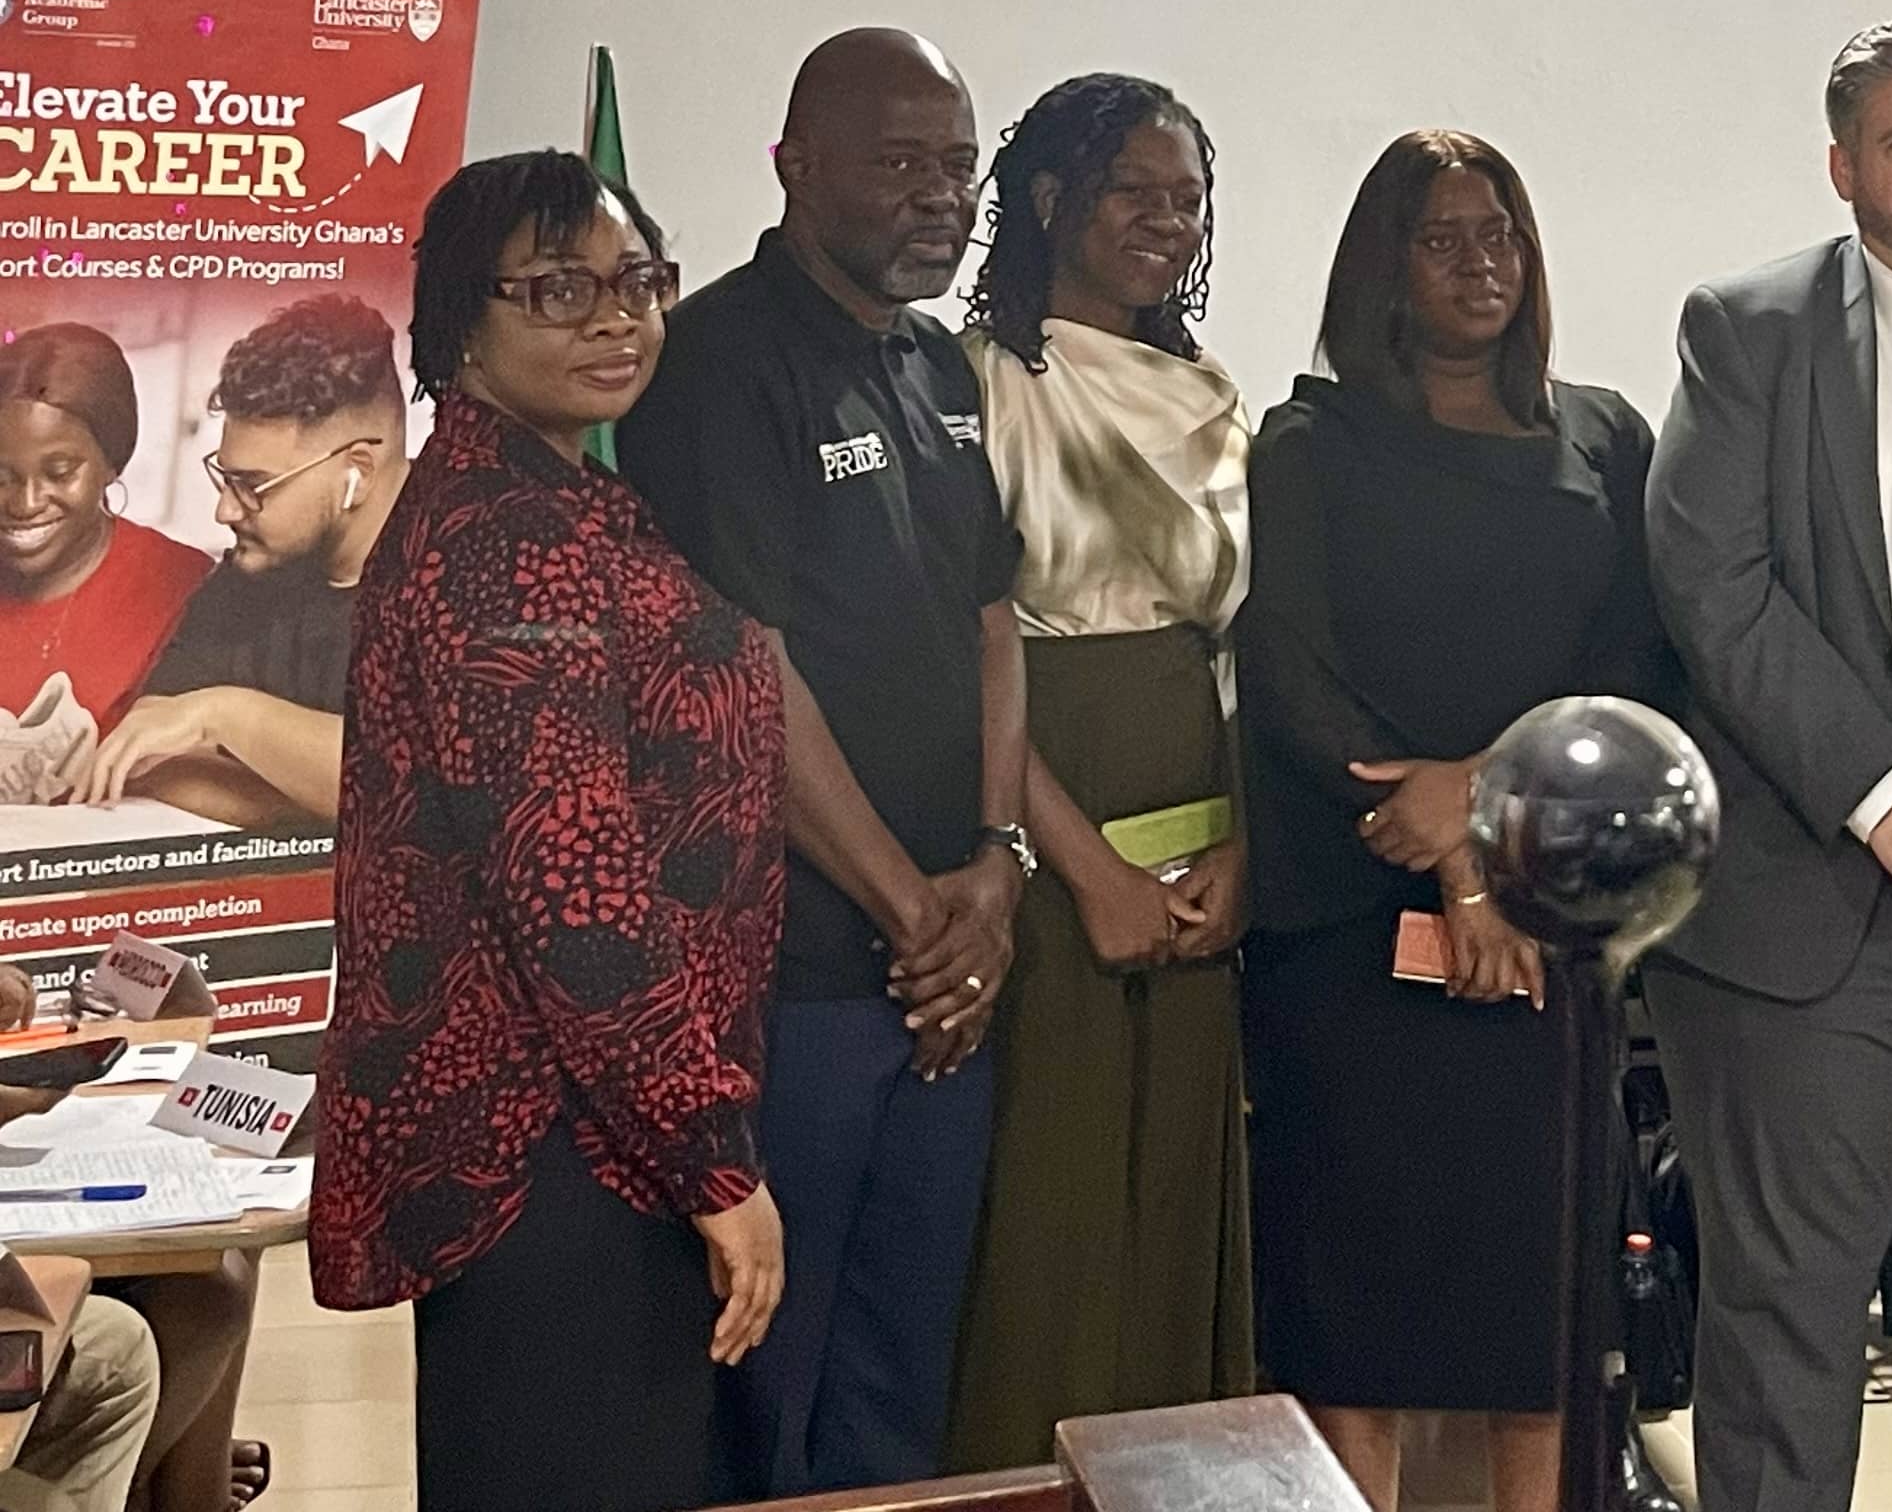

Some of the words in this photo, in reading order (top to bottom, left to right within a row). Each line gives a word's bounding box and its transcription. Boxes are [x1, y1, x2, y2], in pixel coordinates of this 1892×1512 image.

[22, 9, 79, 29] Group
[313, 8, 405, 33] University
[186, 79, 305, 127] Your
[0, 215, 42, 240] roll
[45, 216, 67, 239] in
[71, 216, 192, 241] Lancaster
[195, 218, 312, 248] University
[315, 220, 404, 244] Ghana's
[42, 254, 142, 279] Courses
[146, 255, 164, 279] &
[169, 255, 223, 279] CPD
[227, 257, 345, 285] Programs!
[823, 442, 888, 483] PRIDE
[28, 853, 160, 881] Instructors
[164, 843, 207, 867] and
[212, 837, 334, 863] facilitators
[71, 911, 129, 937] upon
[134, 895, 262, 927] completion
[32, 964, 77, 988] and
[215, 993, 302, 1020] earning
[192, 1084, 277, 1136] TUNISIA
